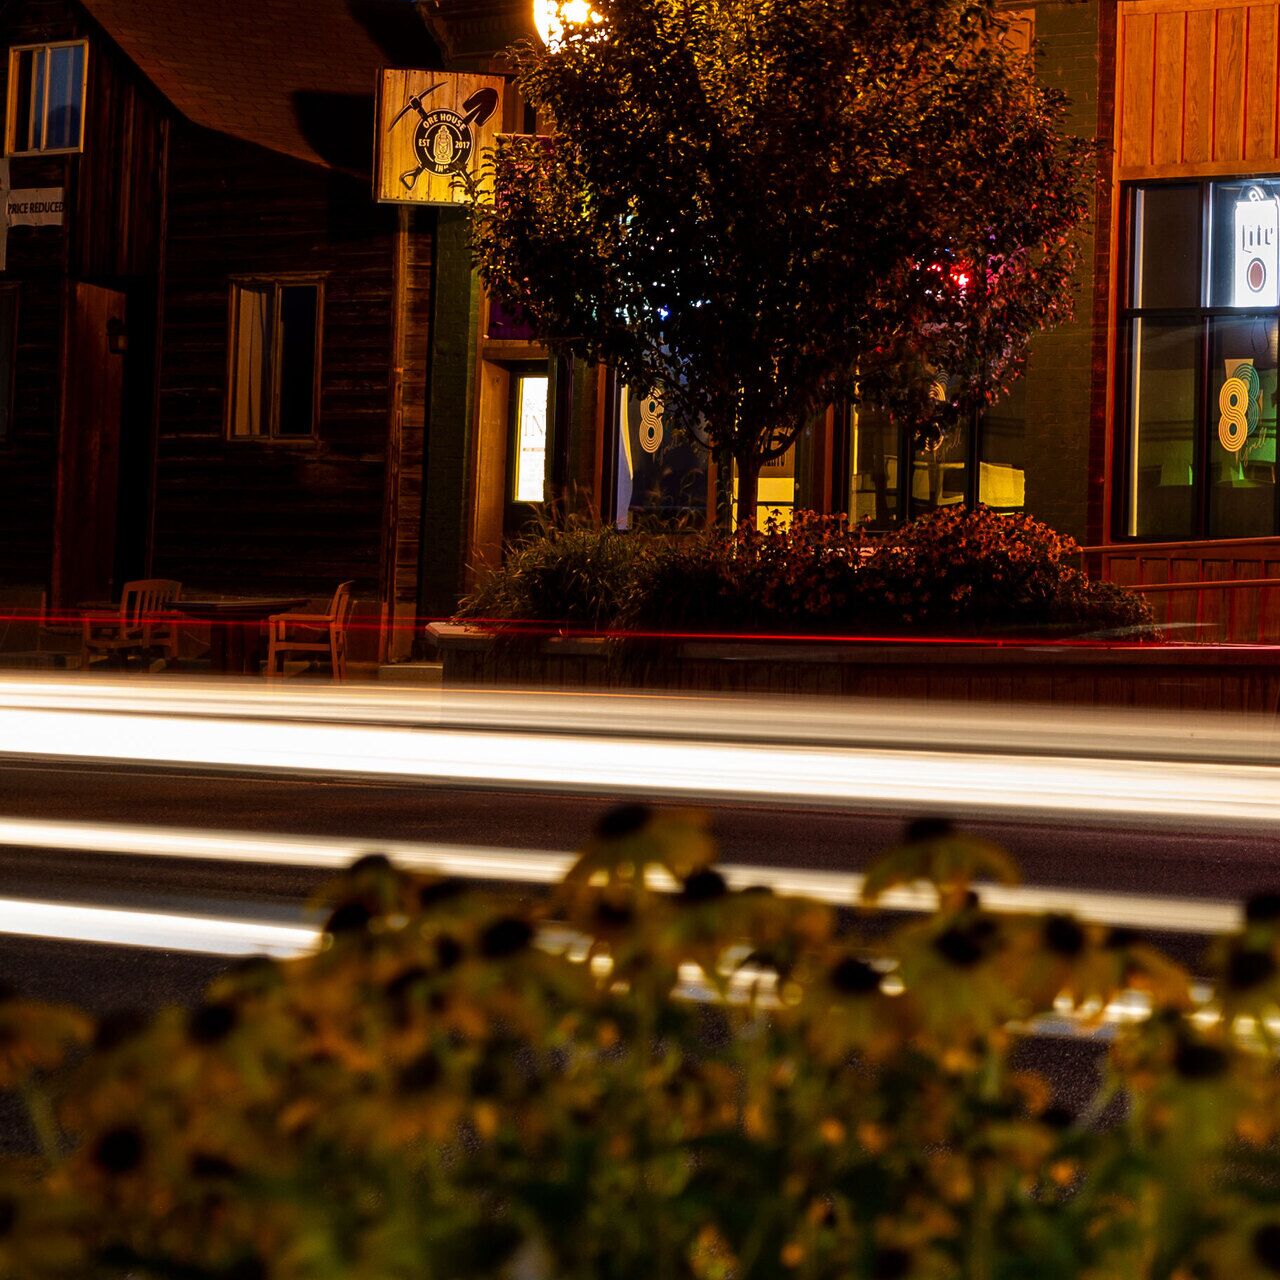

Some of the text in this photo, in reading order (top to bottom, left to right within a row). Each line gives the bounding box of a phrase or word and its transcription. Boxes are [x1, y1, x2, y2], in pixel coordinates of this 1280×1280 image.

[422, 113, 467, 131] ORE HOUSE
[418, 138, 471, 150] EST 2017
[8, 201, 64, 215] PRICE REDUCED
[1241, 224, 1274, 254] Lite
